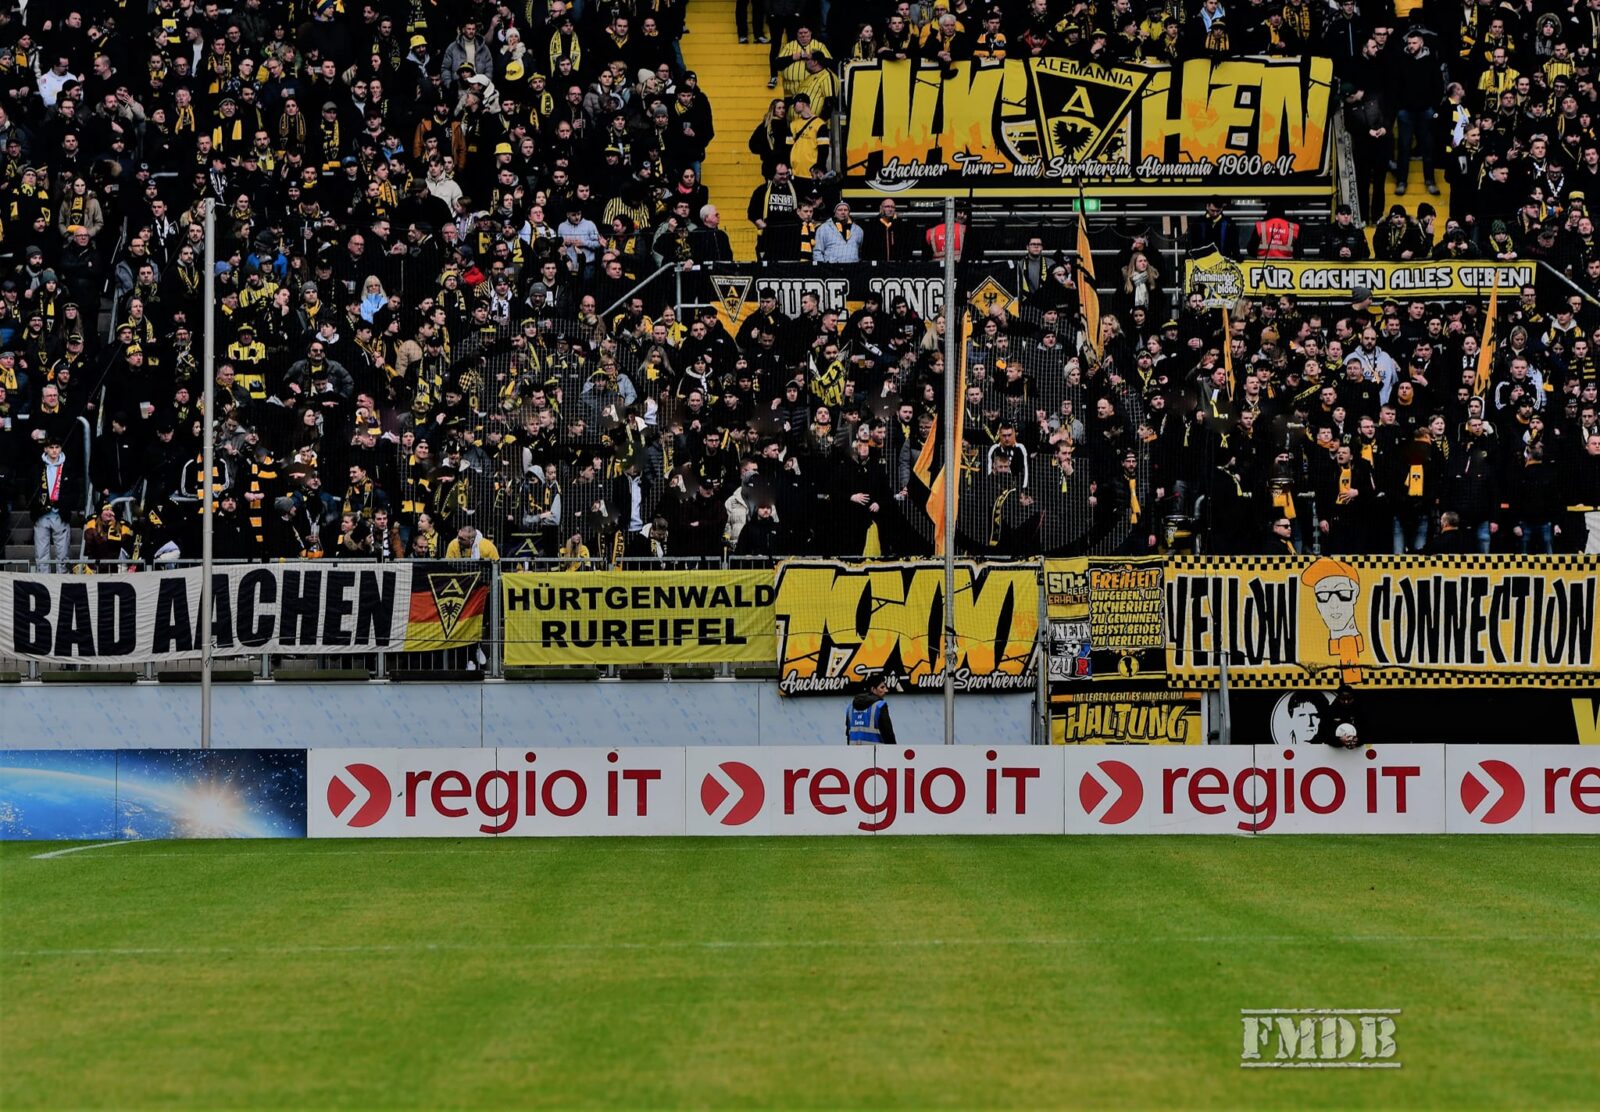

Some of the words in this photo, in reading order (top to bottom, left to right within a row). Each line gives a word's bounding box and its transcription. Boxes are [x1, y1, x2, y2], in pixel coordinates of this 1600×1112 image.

[1036, 57, 1134, 87] ALEMANNIA
[881, 156, 948, 178] Aachener
[953, 152, 1006, 177] Turn-
[1013, 158, 1041, 177] und
[1046, 155, 1130, 179] Sportverein
[1136, 154, 1213, 178] Alemannia
[1217, 154, 1262, 177] 1900
[1250, 265, 1294, 289] FÜR
[1299, 268, 1384, 289] AACHEN
[1389, 267, 1453, 289] ALLES
[1067, 586, 1089, 596] REGE
[1091, 570, 1160, 590] FREIHEIT
[507, 582, 776, 611] HÜRTGENWALD
[1048, 594, 1088, 605] ERHALTE
[1091, 589, 1143, 601] AUFGEBEN,
[1145, 589, 1161, 600] UM
[1091, 600, 1161, 613] SICHERHEIT
[13, 579, 137, 657] BAD
[152, 568, 396, 655] AACHEN
[1091, 613, 1106, 624] ZU
[1166, 575, 1299, 667] YELLOW
[1370, 575, 1595, 666] CONNECTION
[541, 617, 747, 648] RUREIFEL
[1054, 623, 1090, 639] NEIN
[1091, 624, 1125, 636] HEISST
[1127, 624, 1161, 635] BEIDES
[1092, 635, 1106, 648] ZU
[1108, 635, 1162, 647] VERLIEREN
[1051, 656, 1072, 674] ZU
[780, 668, 850, 692] Aachener
[918, 671, 946, 688] und
[953, 667, 1037, 693] Sportverein
[1085, 692, 1109, 702] LEBEN
[1110, 692, 1130, 702] GEHT
[1131, 691, 1141, 701] ES
[1142, 691, 1169, 701] IMMER
[1170, 690, 1183, 700] UM
[1065, 703, 1188, 741] HALTUNG
[404, 751, 588, 835] regio
[607, 751, 662, 817] iT
[784, 749, 967, 832] regio
[985, 749, 1041, 815] iT
[1161, 749, 1347, 832] regio
[1365, 748, 1421, 815] iT
